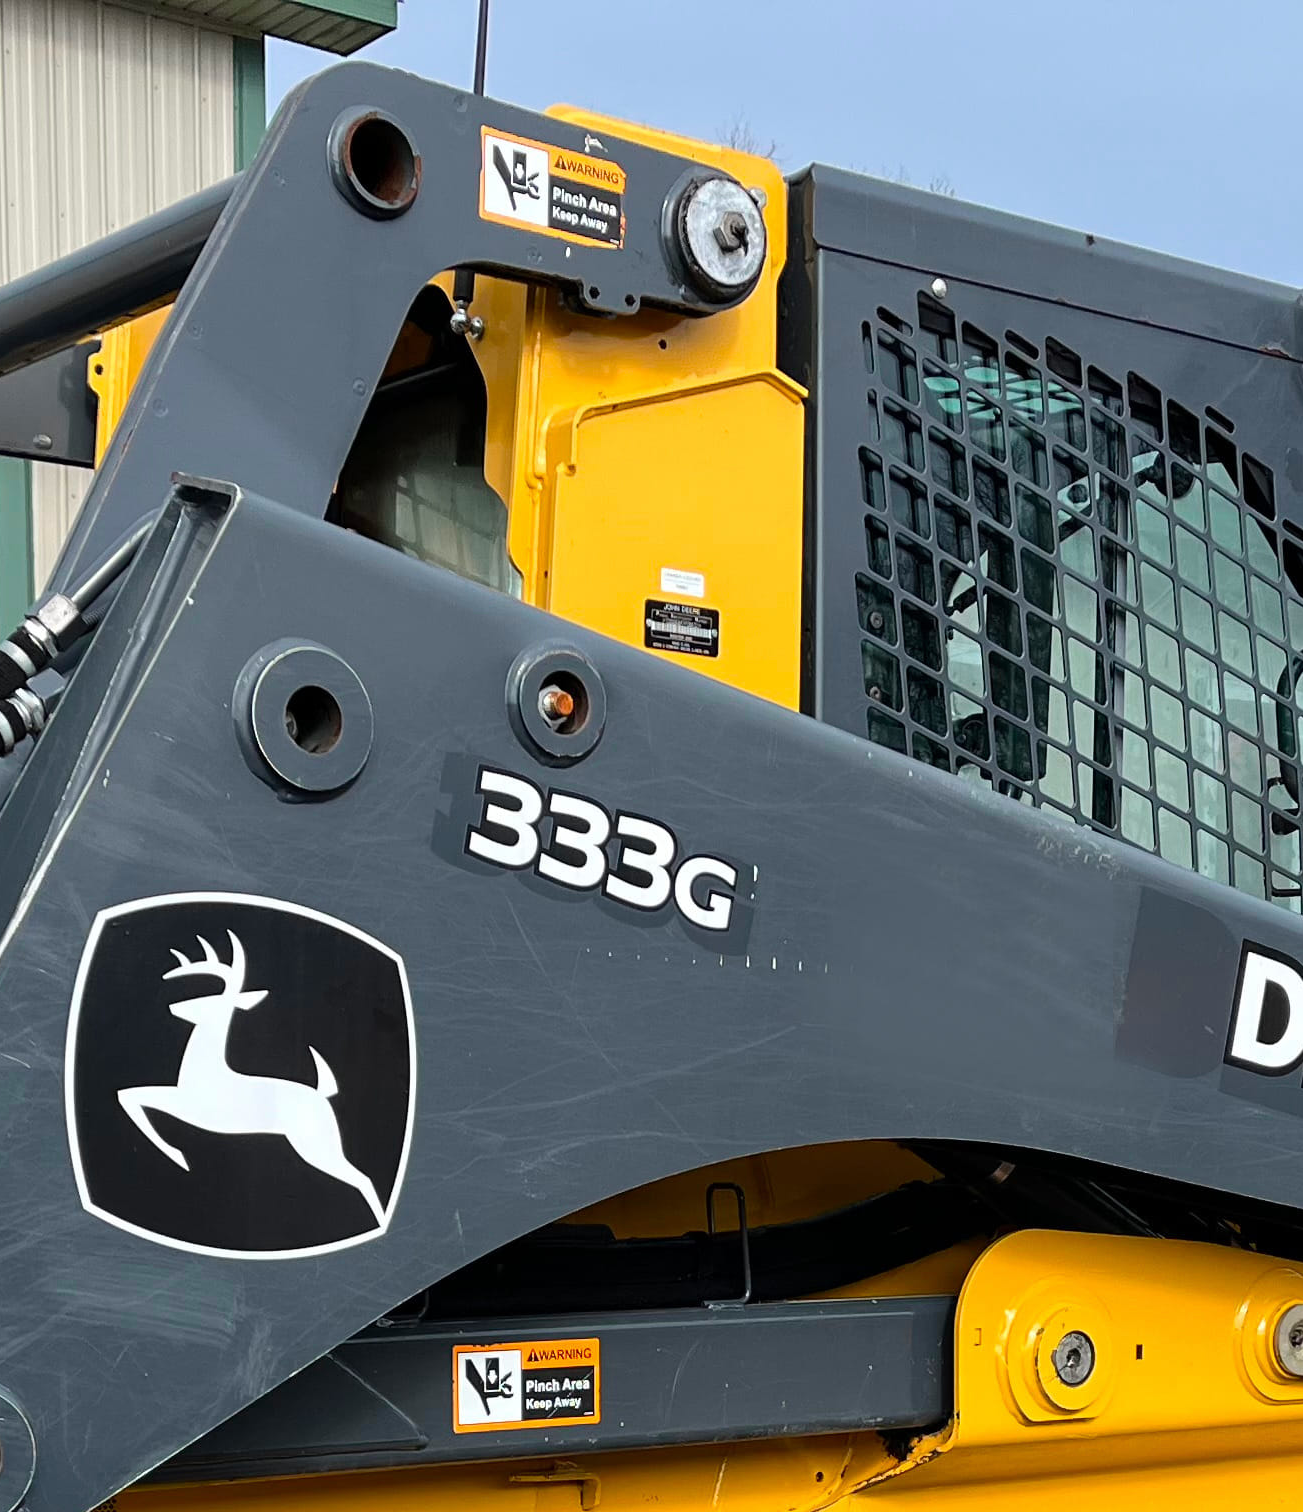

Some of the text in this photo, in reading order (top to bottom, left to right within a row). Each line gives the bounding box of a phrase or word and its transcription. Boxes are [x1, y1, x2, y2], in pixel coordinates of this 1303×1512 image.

[566, 159, 619, 184] WARNING
[552, 186, 617, 217] Pinch Area
[552, 205, 608, 234] Keep Away
[465, 765, 738, 931] 333G
[539, 1347, 592, 1361] WARNING
[525, 1377, 591, 1393] Pinch Area
[525, 1396, 582, 1411] Keep Away
